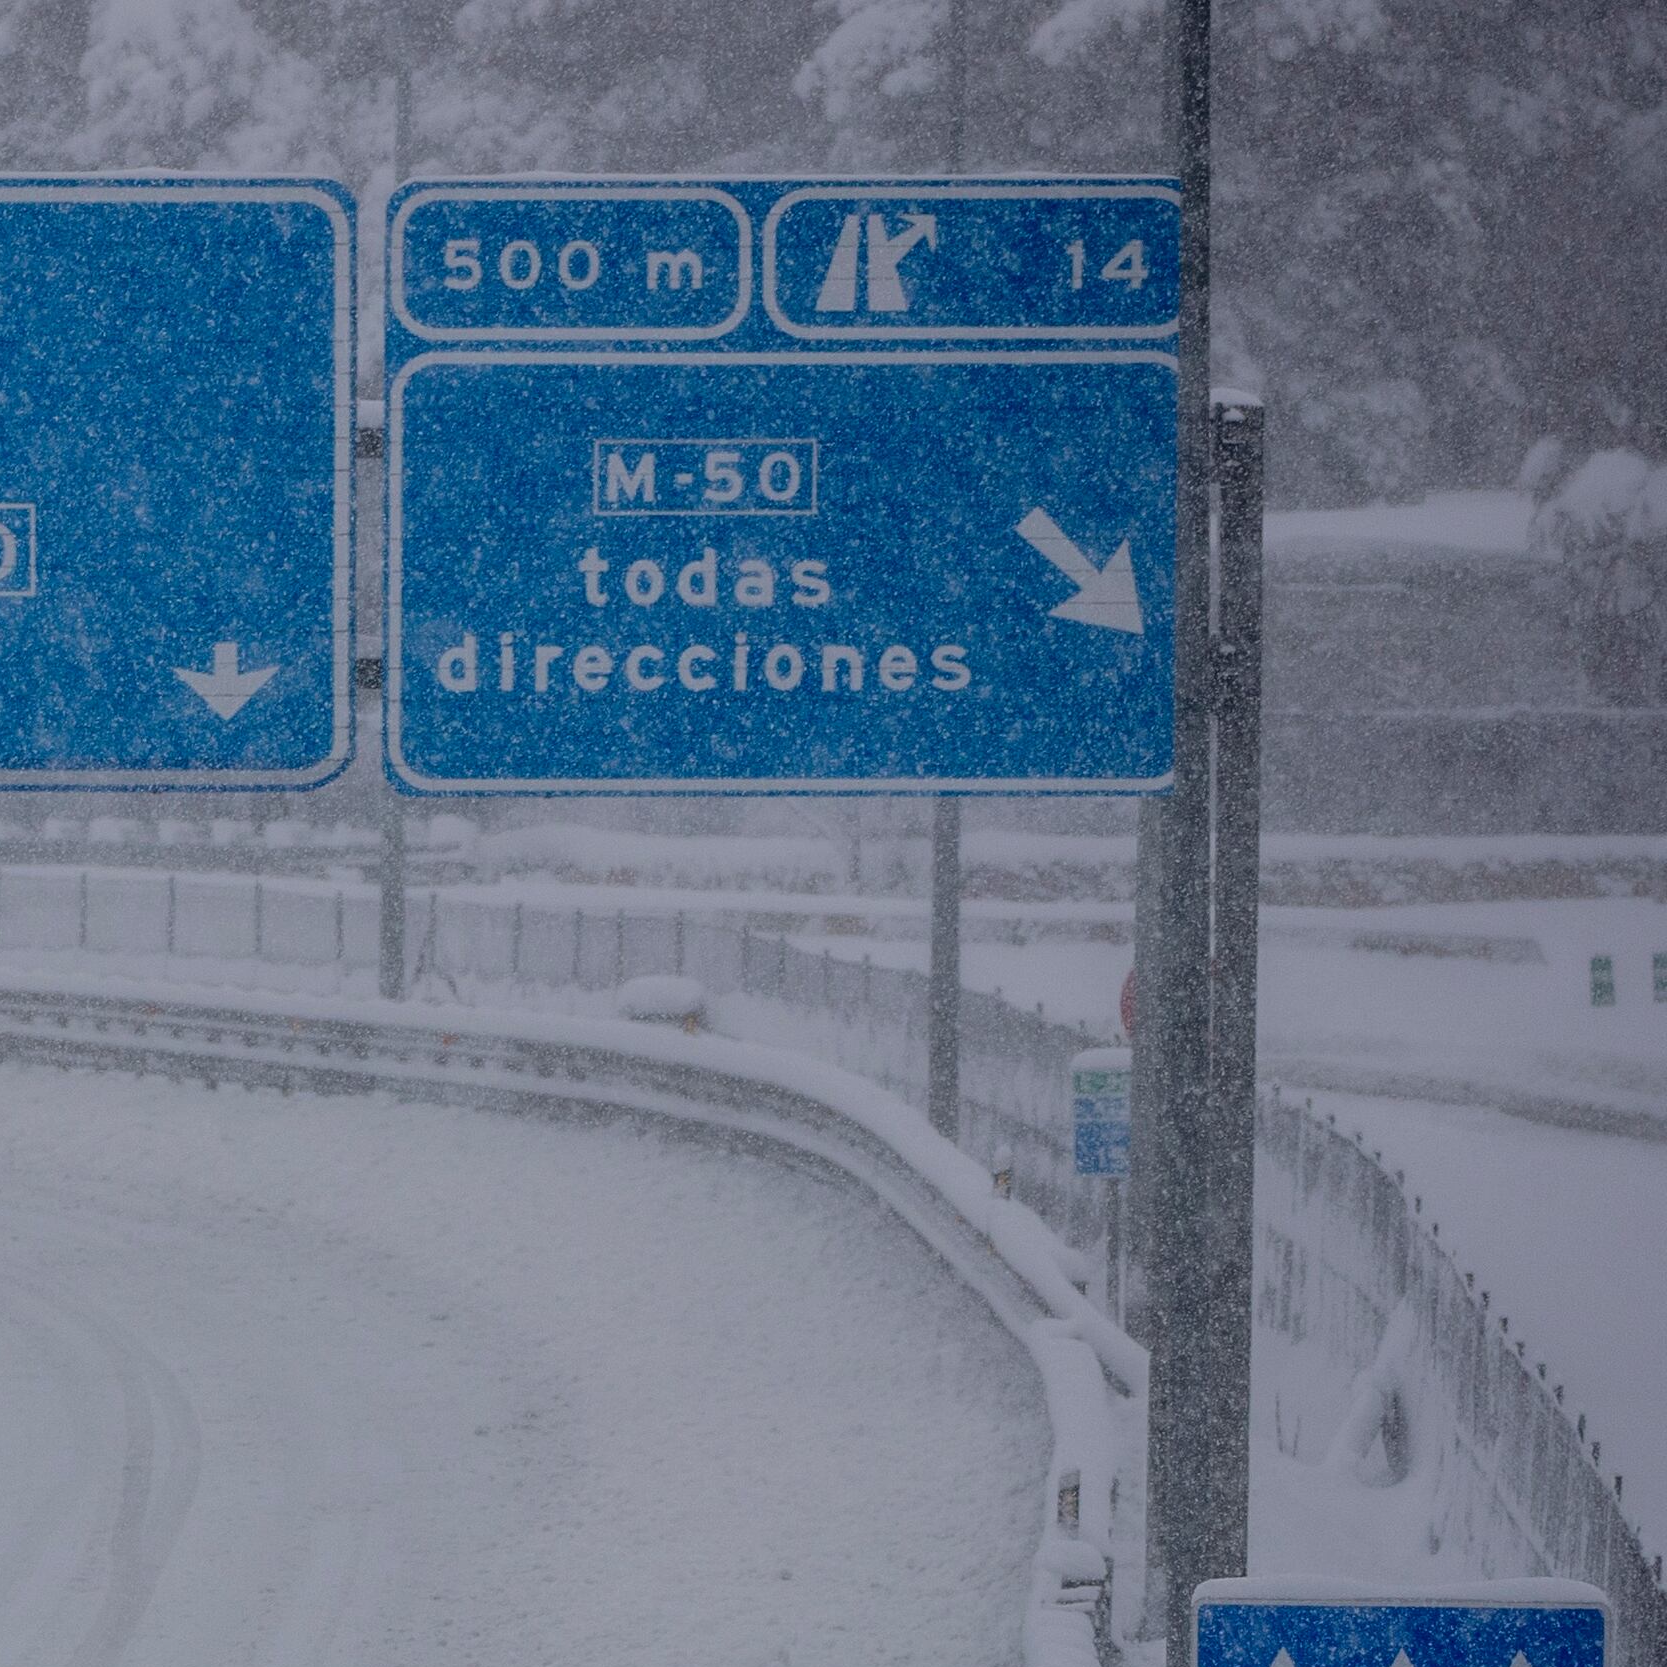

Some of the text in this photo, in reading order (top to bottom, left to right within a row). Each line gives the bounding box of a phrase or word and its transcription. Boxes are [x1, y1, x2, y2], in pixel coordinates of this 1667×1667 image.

[443, 241, 704, 291] 500 m
[1065, 241, 1147, 290] 14
[604, 452, 802, 503] M-50
[579, 549, 831, 607] todas
[437, 636, 972, 693] direcciones
